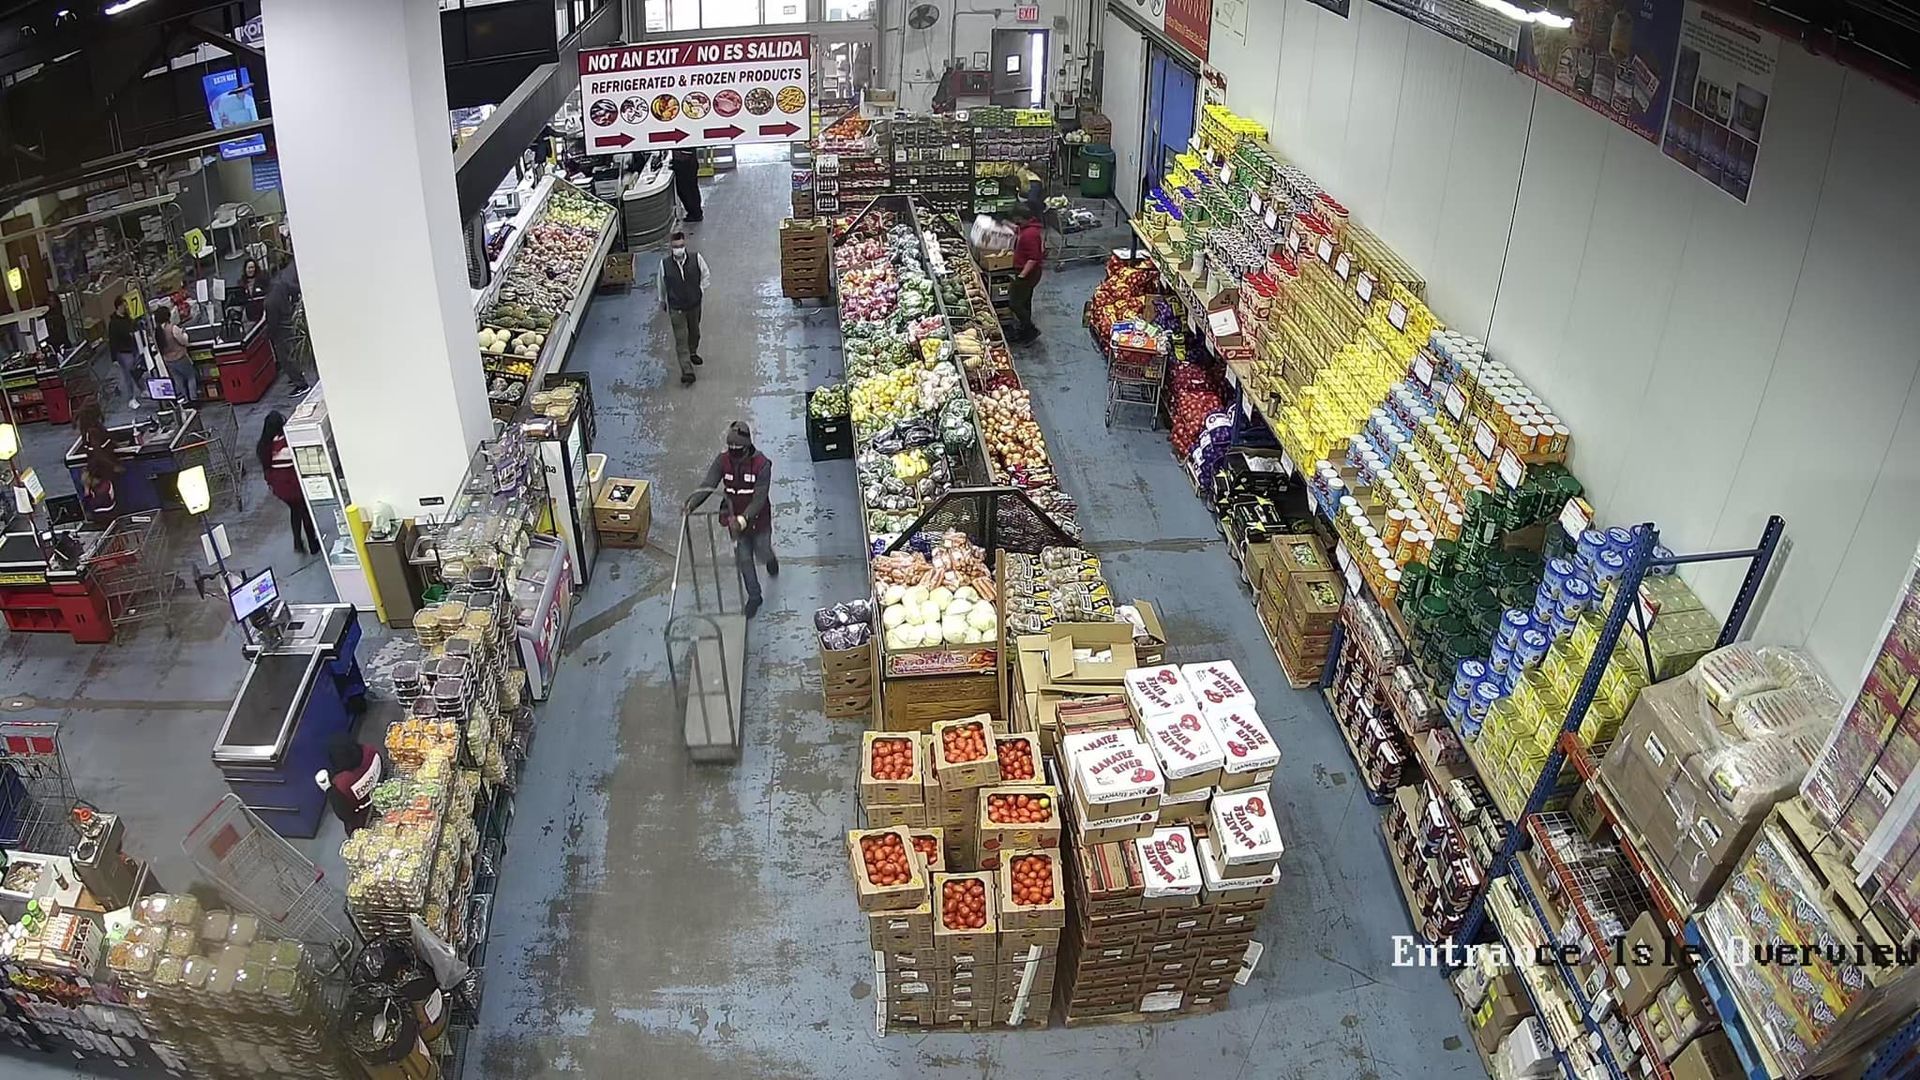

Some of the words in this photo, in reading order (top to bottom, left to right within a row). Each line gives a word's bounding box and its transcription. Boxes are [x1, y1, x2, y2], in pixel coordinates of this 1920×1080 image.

[1019, 7, 1036, 19] EXIT
[588, 54, 618, 72] NOT
[621, 51, 642, 69] AN
[646, 48, 678, 66] EXIT
[682, 44, 693, 63] /
[697, 43, 720, 62] NO
[723, 42, 744, 60] ES
[746, 40, 803, 59] SALIDA
[591, 75, 675, 95] REFRIGERATED
[678, 73, 687, 87] &
[690, 71, 736, 86] FROZEN
[739, 67, 802, 83] PRODUCTS
[192, 235, 199, 251] 9
[131, 297, 139, 315] 7
[1207, 666, 1245, 694] MANATEE
[1213, 680, 1235, 698] RIVER
[1230, 713, 1269, 745] MANATEE
[1236, 729, 1259, 750] RIVER
[1089, 749, 1135, 775] MANATEE
[1112, 759, 1143, 774] RIVER
